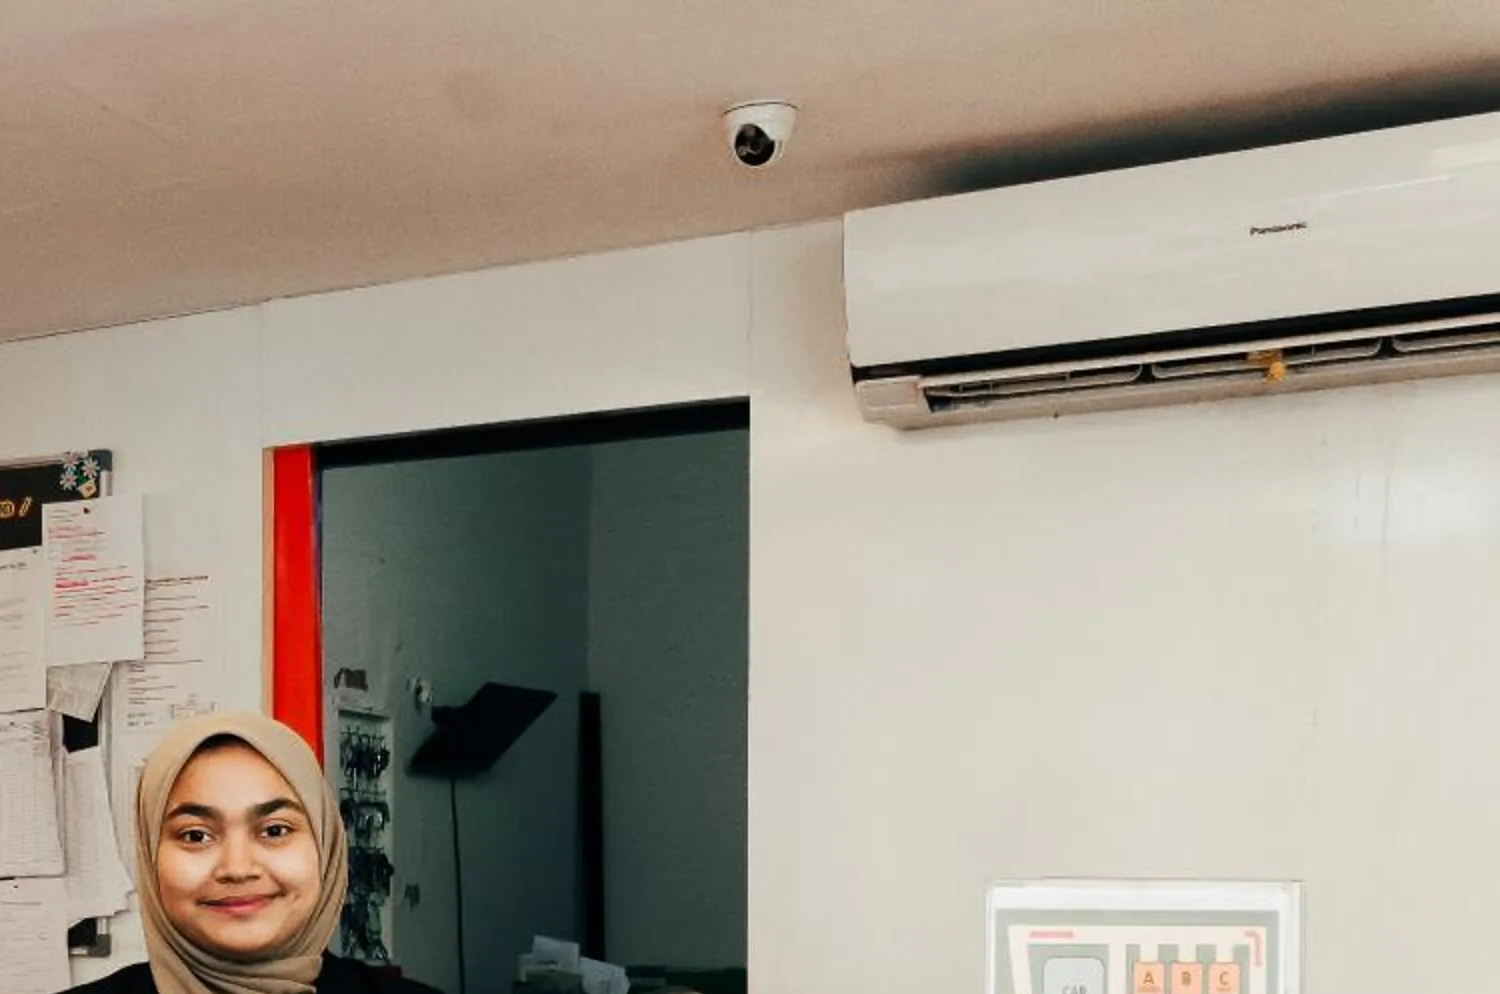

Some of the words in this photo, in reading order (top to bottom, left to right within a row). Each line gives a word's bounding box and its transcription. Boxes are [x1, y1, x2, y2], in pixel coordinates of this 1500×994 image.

[1143, 970, 1155, 985] A
[1181, 971, 1191, 986] B
[1219, 971, 1230, 986] C
